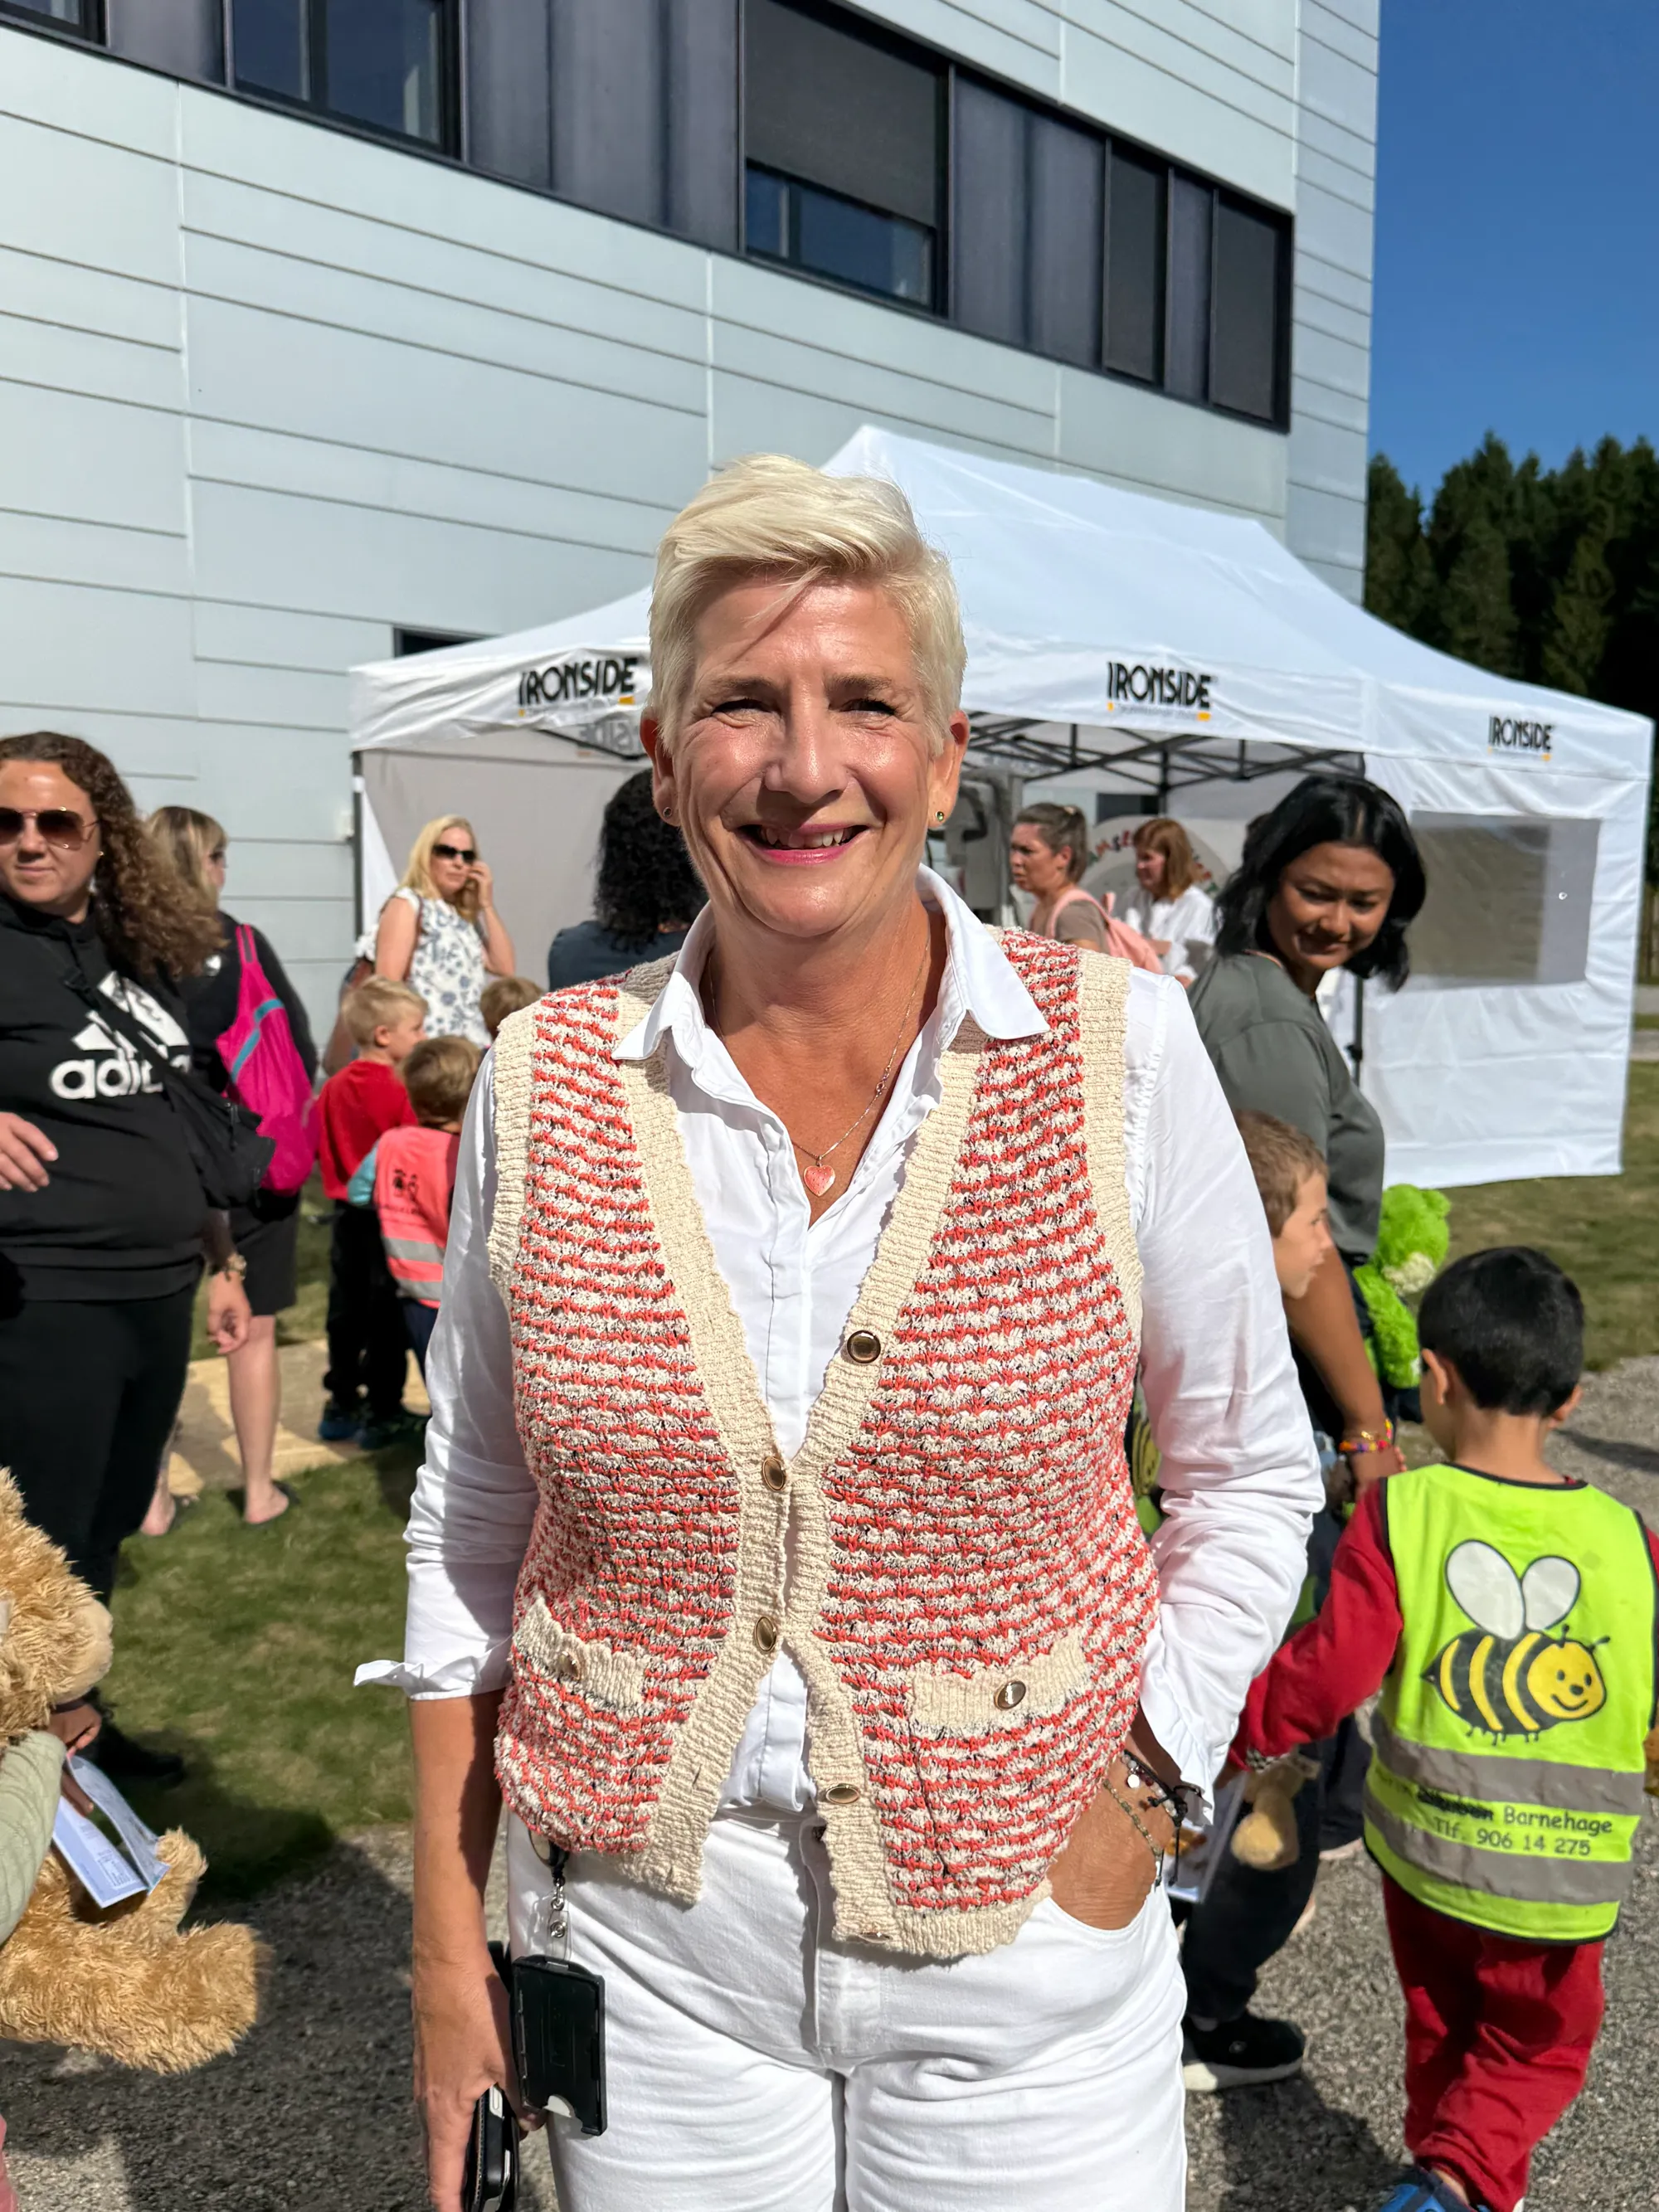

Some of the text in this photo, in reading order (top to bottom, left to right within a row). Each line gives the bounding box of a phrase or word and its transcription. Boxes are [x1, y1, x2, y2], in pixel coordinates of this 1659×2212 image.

[519, 658, 638, 705] IRONSIDE
[1108, 662, 1212, 708] IRONSIDE
[1488, 716, 1552, 752] IRONSIDE
[1433, 1816, 1591, 1856] Tlf. 906 14 275
[1504, 1805, 1613, 1836] Barnehage
